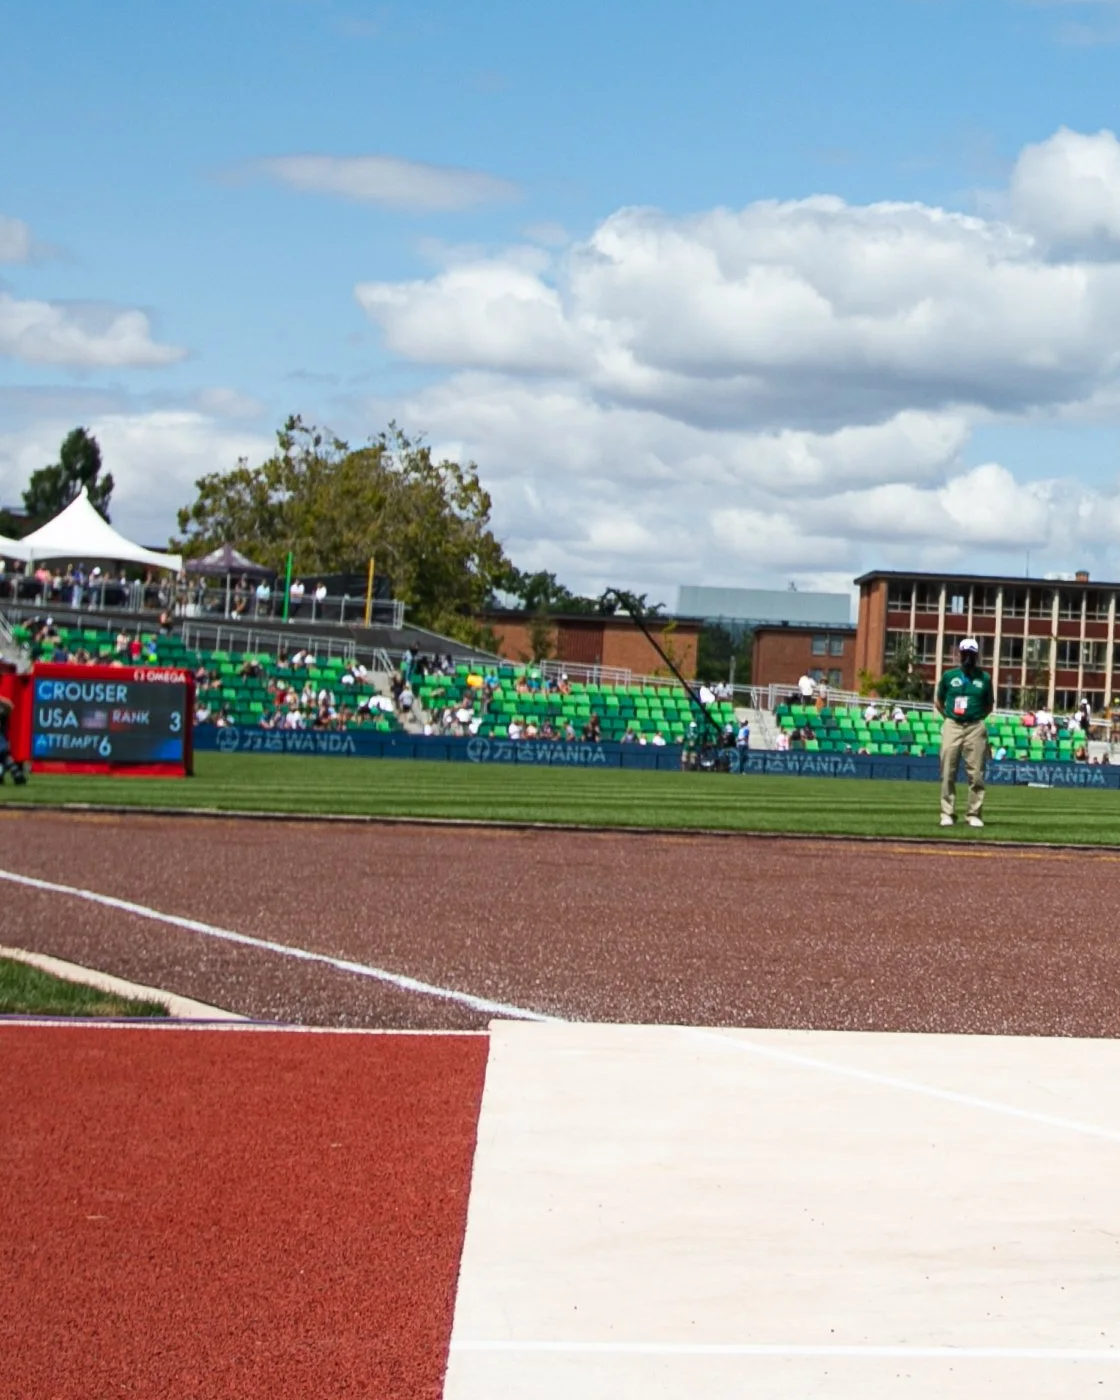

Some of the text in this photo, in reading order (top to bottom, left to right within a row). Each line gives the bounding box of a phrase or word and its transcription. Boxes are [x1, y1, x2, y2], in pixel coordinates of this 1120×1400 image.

[147, 673, 186, 683] OMEGA
[38, 681, 128, 703] CROUSER
[39, 708, 182, 732] USA RANK 3
[37, 733, 112, 757] ATTEMPT 6
[286, 732, 356, 752] WANDA
[535, 743, 606, 763] WANDA
[786, 755, 856, 774] WANDA
[1036, 765, 1106, 784] WANDA
